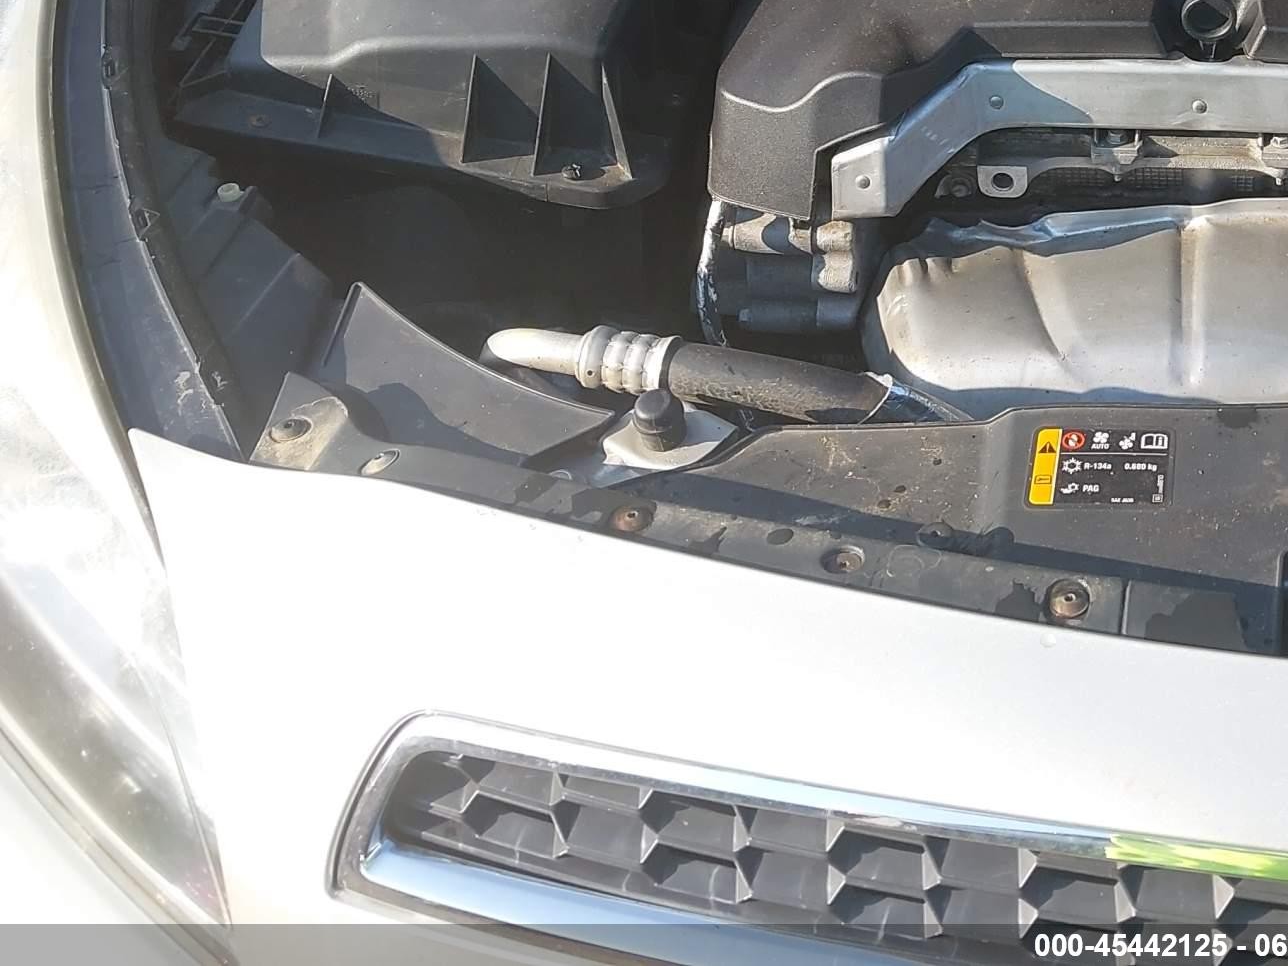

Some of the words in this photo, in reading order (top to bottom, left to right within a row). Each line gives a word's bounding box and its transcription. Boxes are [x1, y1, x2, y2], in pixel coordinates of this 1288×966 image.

[1084, 462, 1112, 470] R-134a
[1147, 463, 1157, 472] kg
[1082, 484, 1100, 492] PAG
